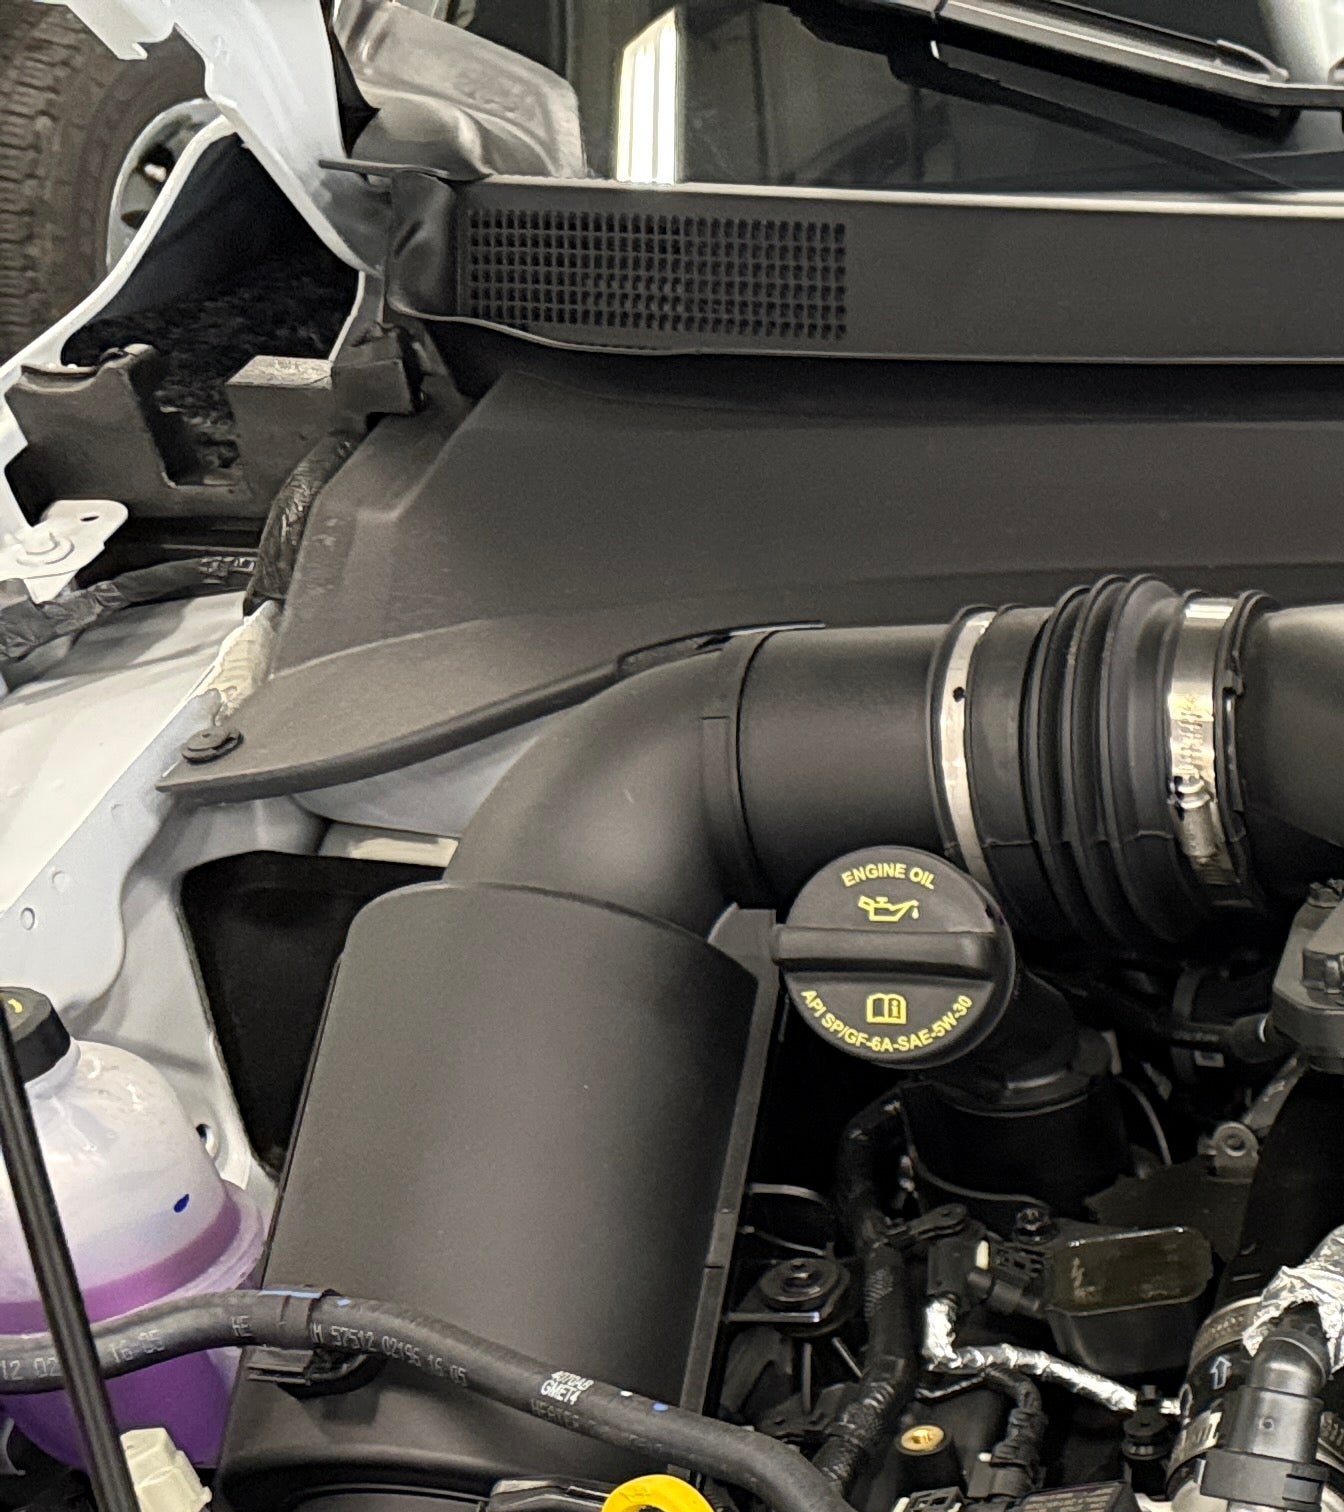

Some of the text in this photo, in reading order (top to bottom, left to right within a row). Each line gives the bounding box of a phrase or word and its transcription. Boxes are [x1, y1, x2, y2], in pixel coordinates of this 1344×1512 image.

[841, 862, 936, 890] ENGINE OIL
[801, 989, 827, 1018] API
